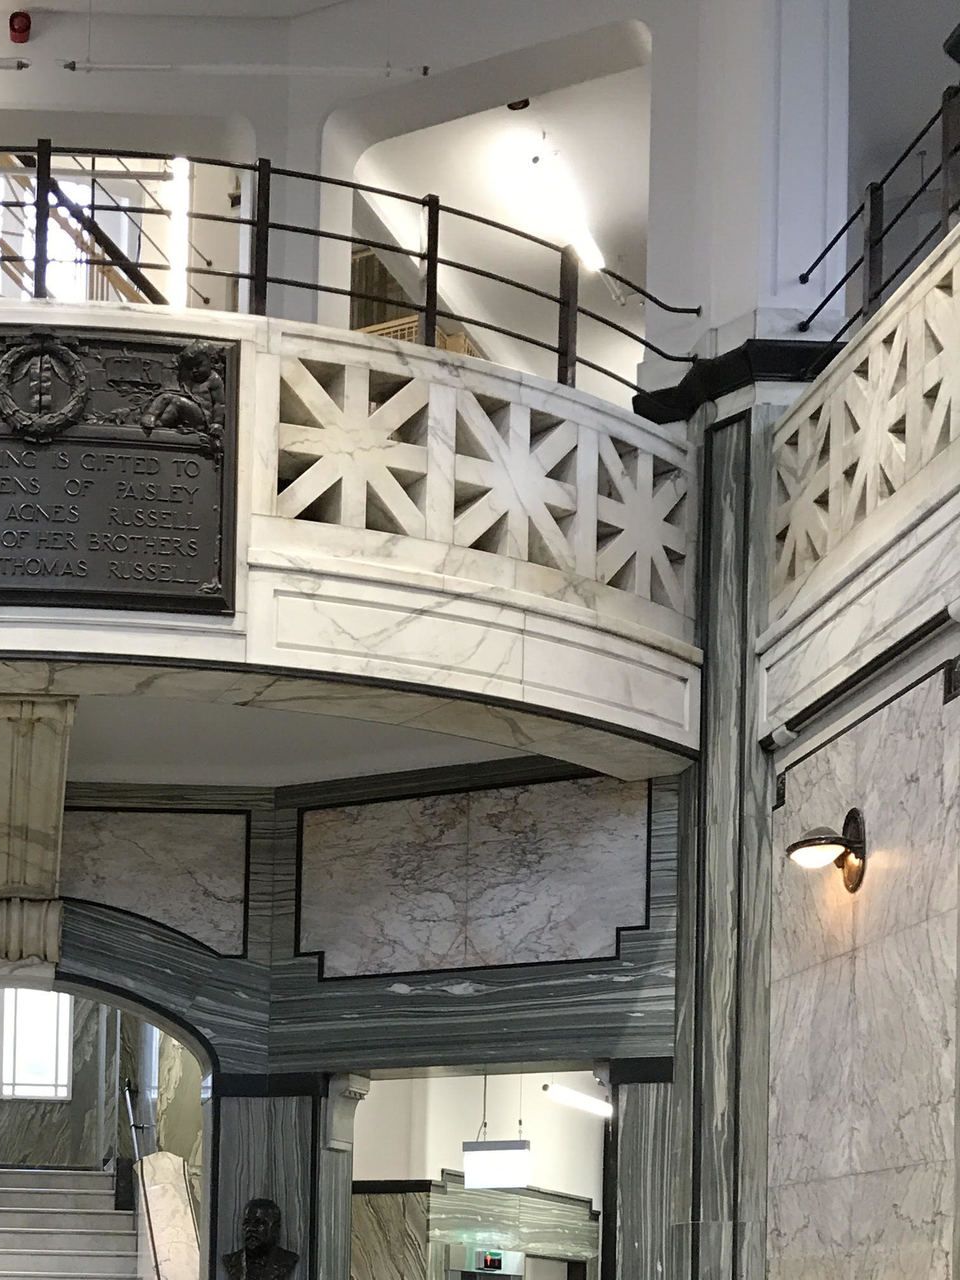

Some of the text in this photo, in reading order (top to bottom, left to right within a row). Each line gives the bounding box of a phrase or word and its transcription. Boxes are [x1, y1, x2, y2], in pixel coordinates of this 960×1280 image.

[52, 451, 71, 470] IS
[80, 453, 160, 475] GIFTED
[171, 458, 200, 478] TO
[64, 478, 94, 497] OF
[116, 480, 199, 504] PAISLEY
[5, 503, 80, 522] AGNES
[108, 506, 200, 531] RUSSELL
[0, 529, 30, 549] OF
[36, 530, 78, 550] HER
[88, 532, 198, 557] BROTHERS
[108, 560, 200, 584] RUSSELL
